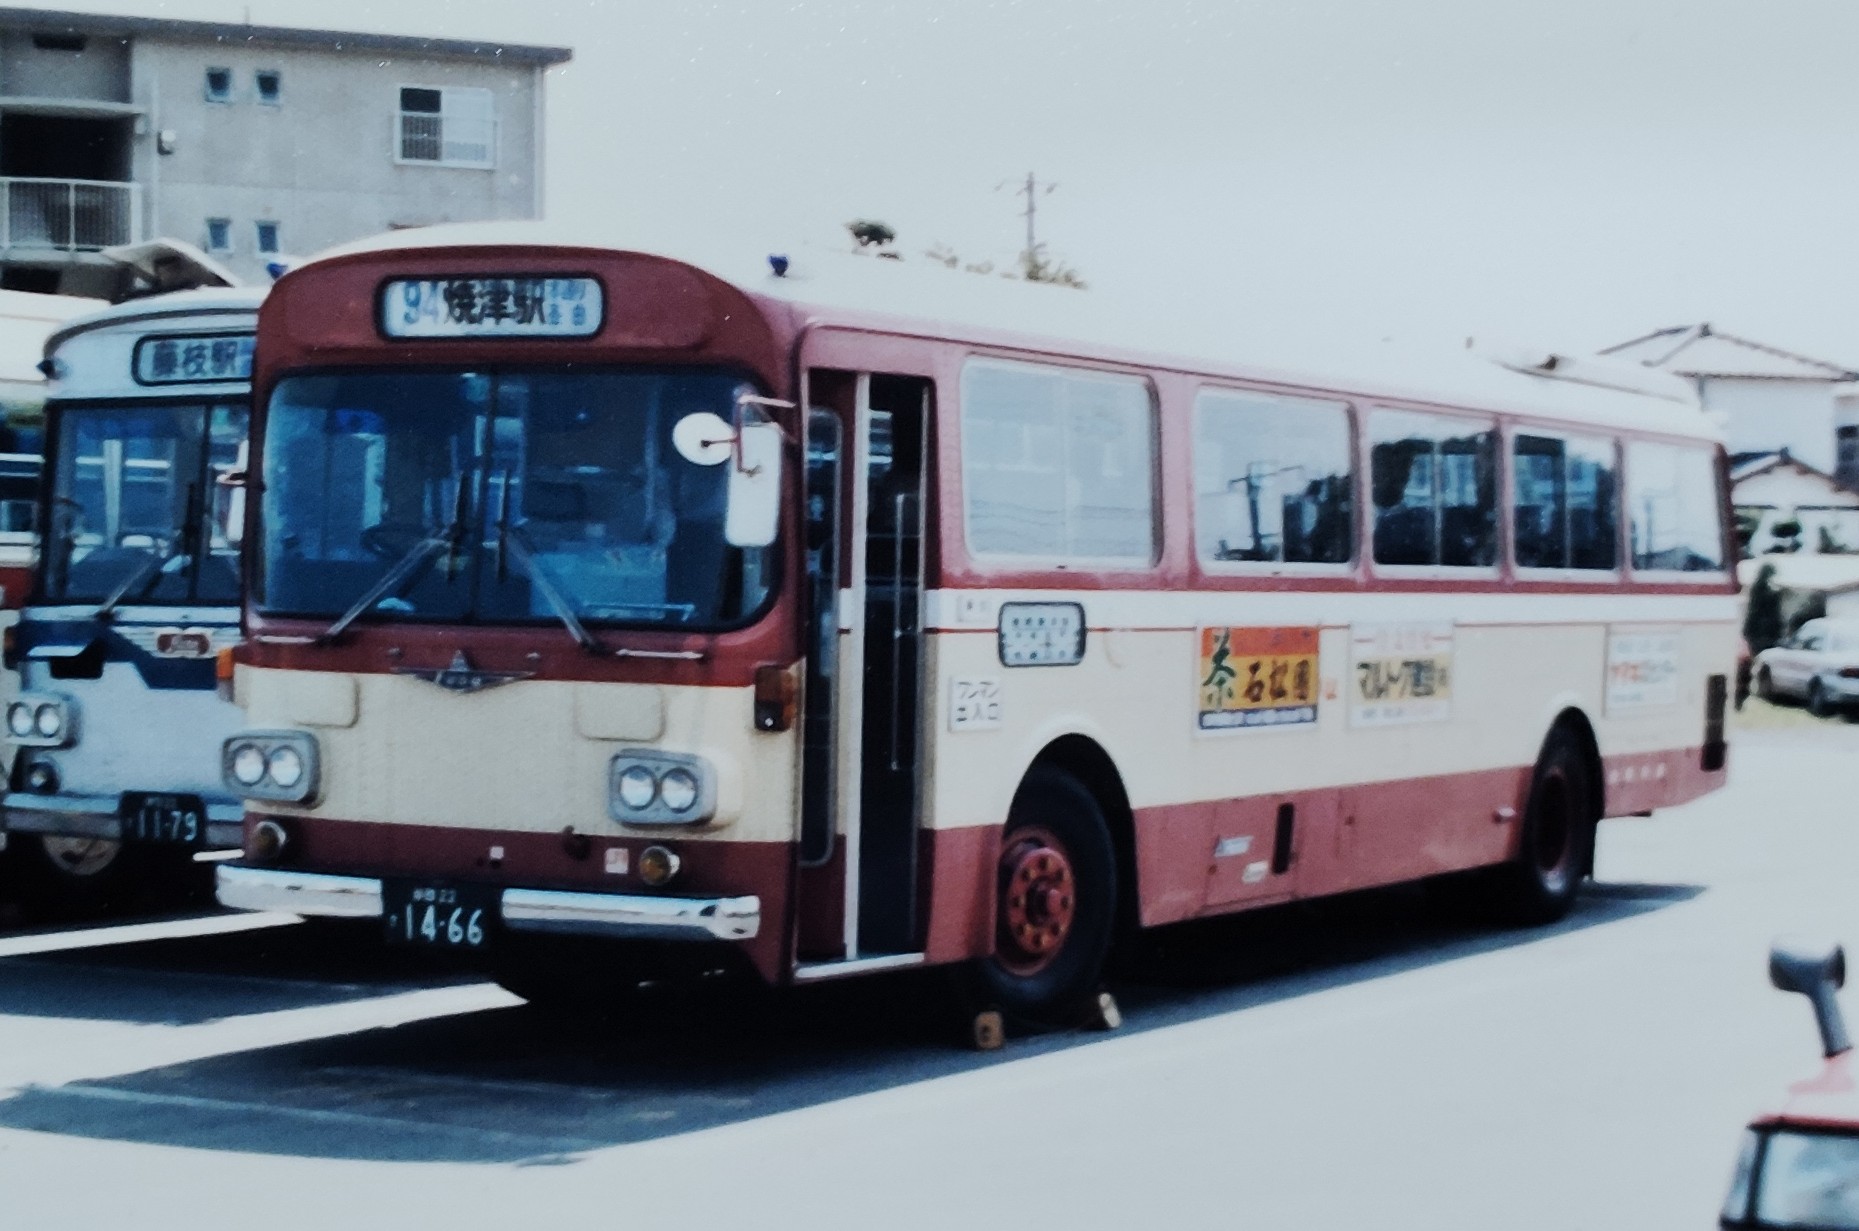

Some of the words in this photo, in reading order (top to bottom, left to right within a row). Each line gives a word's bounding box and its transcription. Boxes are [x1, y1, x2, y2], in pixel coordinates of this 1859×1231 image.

[443, 280, 546, 325] 焼津駅
[1202, 627, 1236, 708] 茶
[406, 904, 483, 945] 14-66
